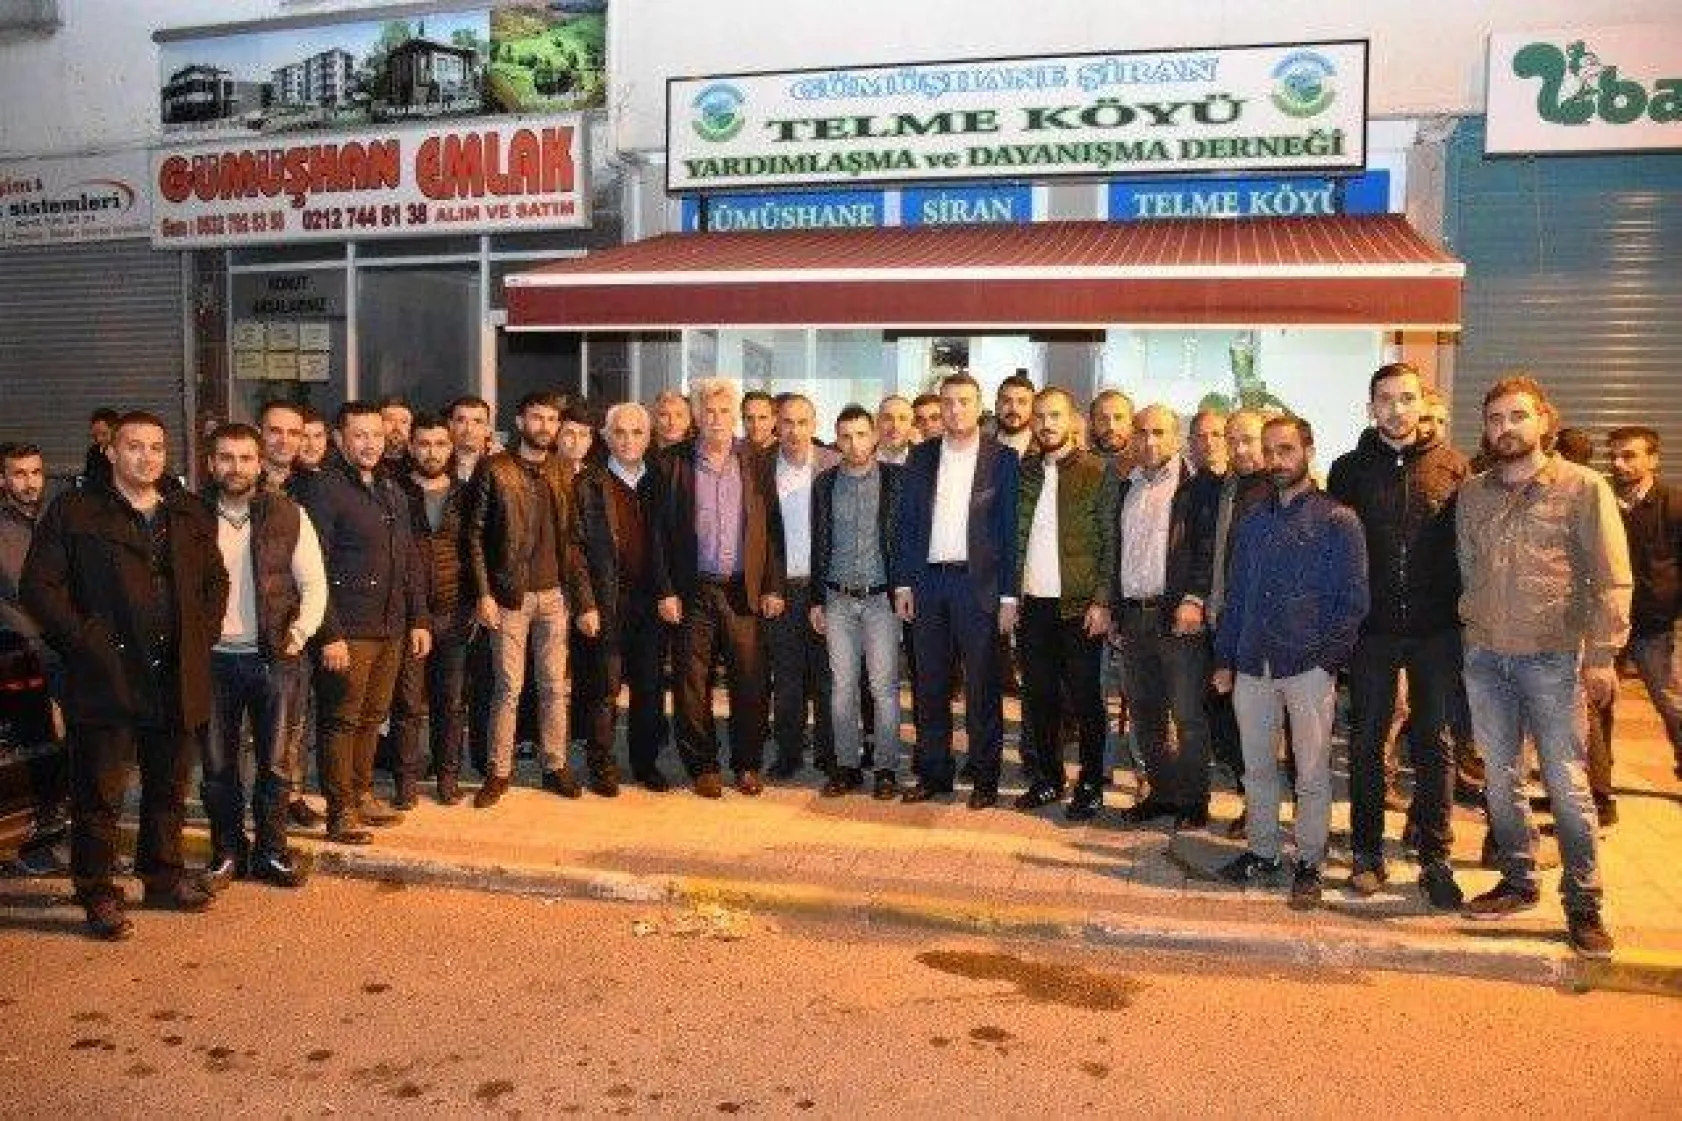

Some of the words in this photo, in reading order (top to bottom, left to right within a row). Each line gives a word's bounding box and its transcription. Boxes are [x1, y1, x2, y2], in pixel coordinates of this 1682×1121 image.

[790, 67, 1068, 101] GÜMÜŞHANE
[766, 110, 1000, 142] TELME
[1023, 94, 1246, 131] KÖYÜ
[159, 139, 400, 208] GÜMÜŞHAN
[416, 126, 576, 200] EMLAK
[683, 148, 917, 179] YARDIMLAŞMA
[924, 152, 960, 169] ve
[966, 139, 1170, 168] DAYANIŞMA
[1177, 128, 1346, 160] DERNEĞİ
[10, 192, 119, 216] sistemleri
[302, 207, 343, 230] 0212
[346, 205, 377, 228] 744
[486, 203, 510, 219] VE
[515, 201, 575, 218] SATIM
[1134, 193, 1237, 218] TELME
